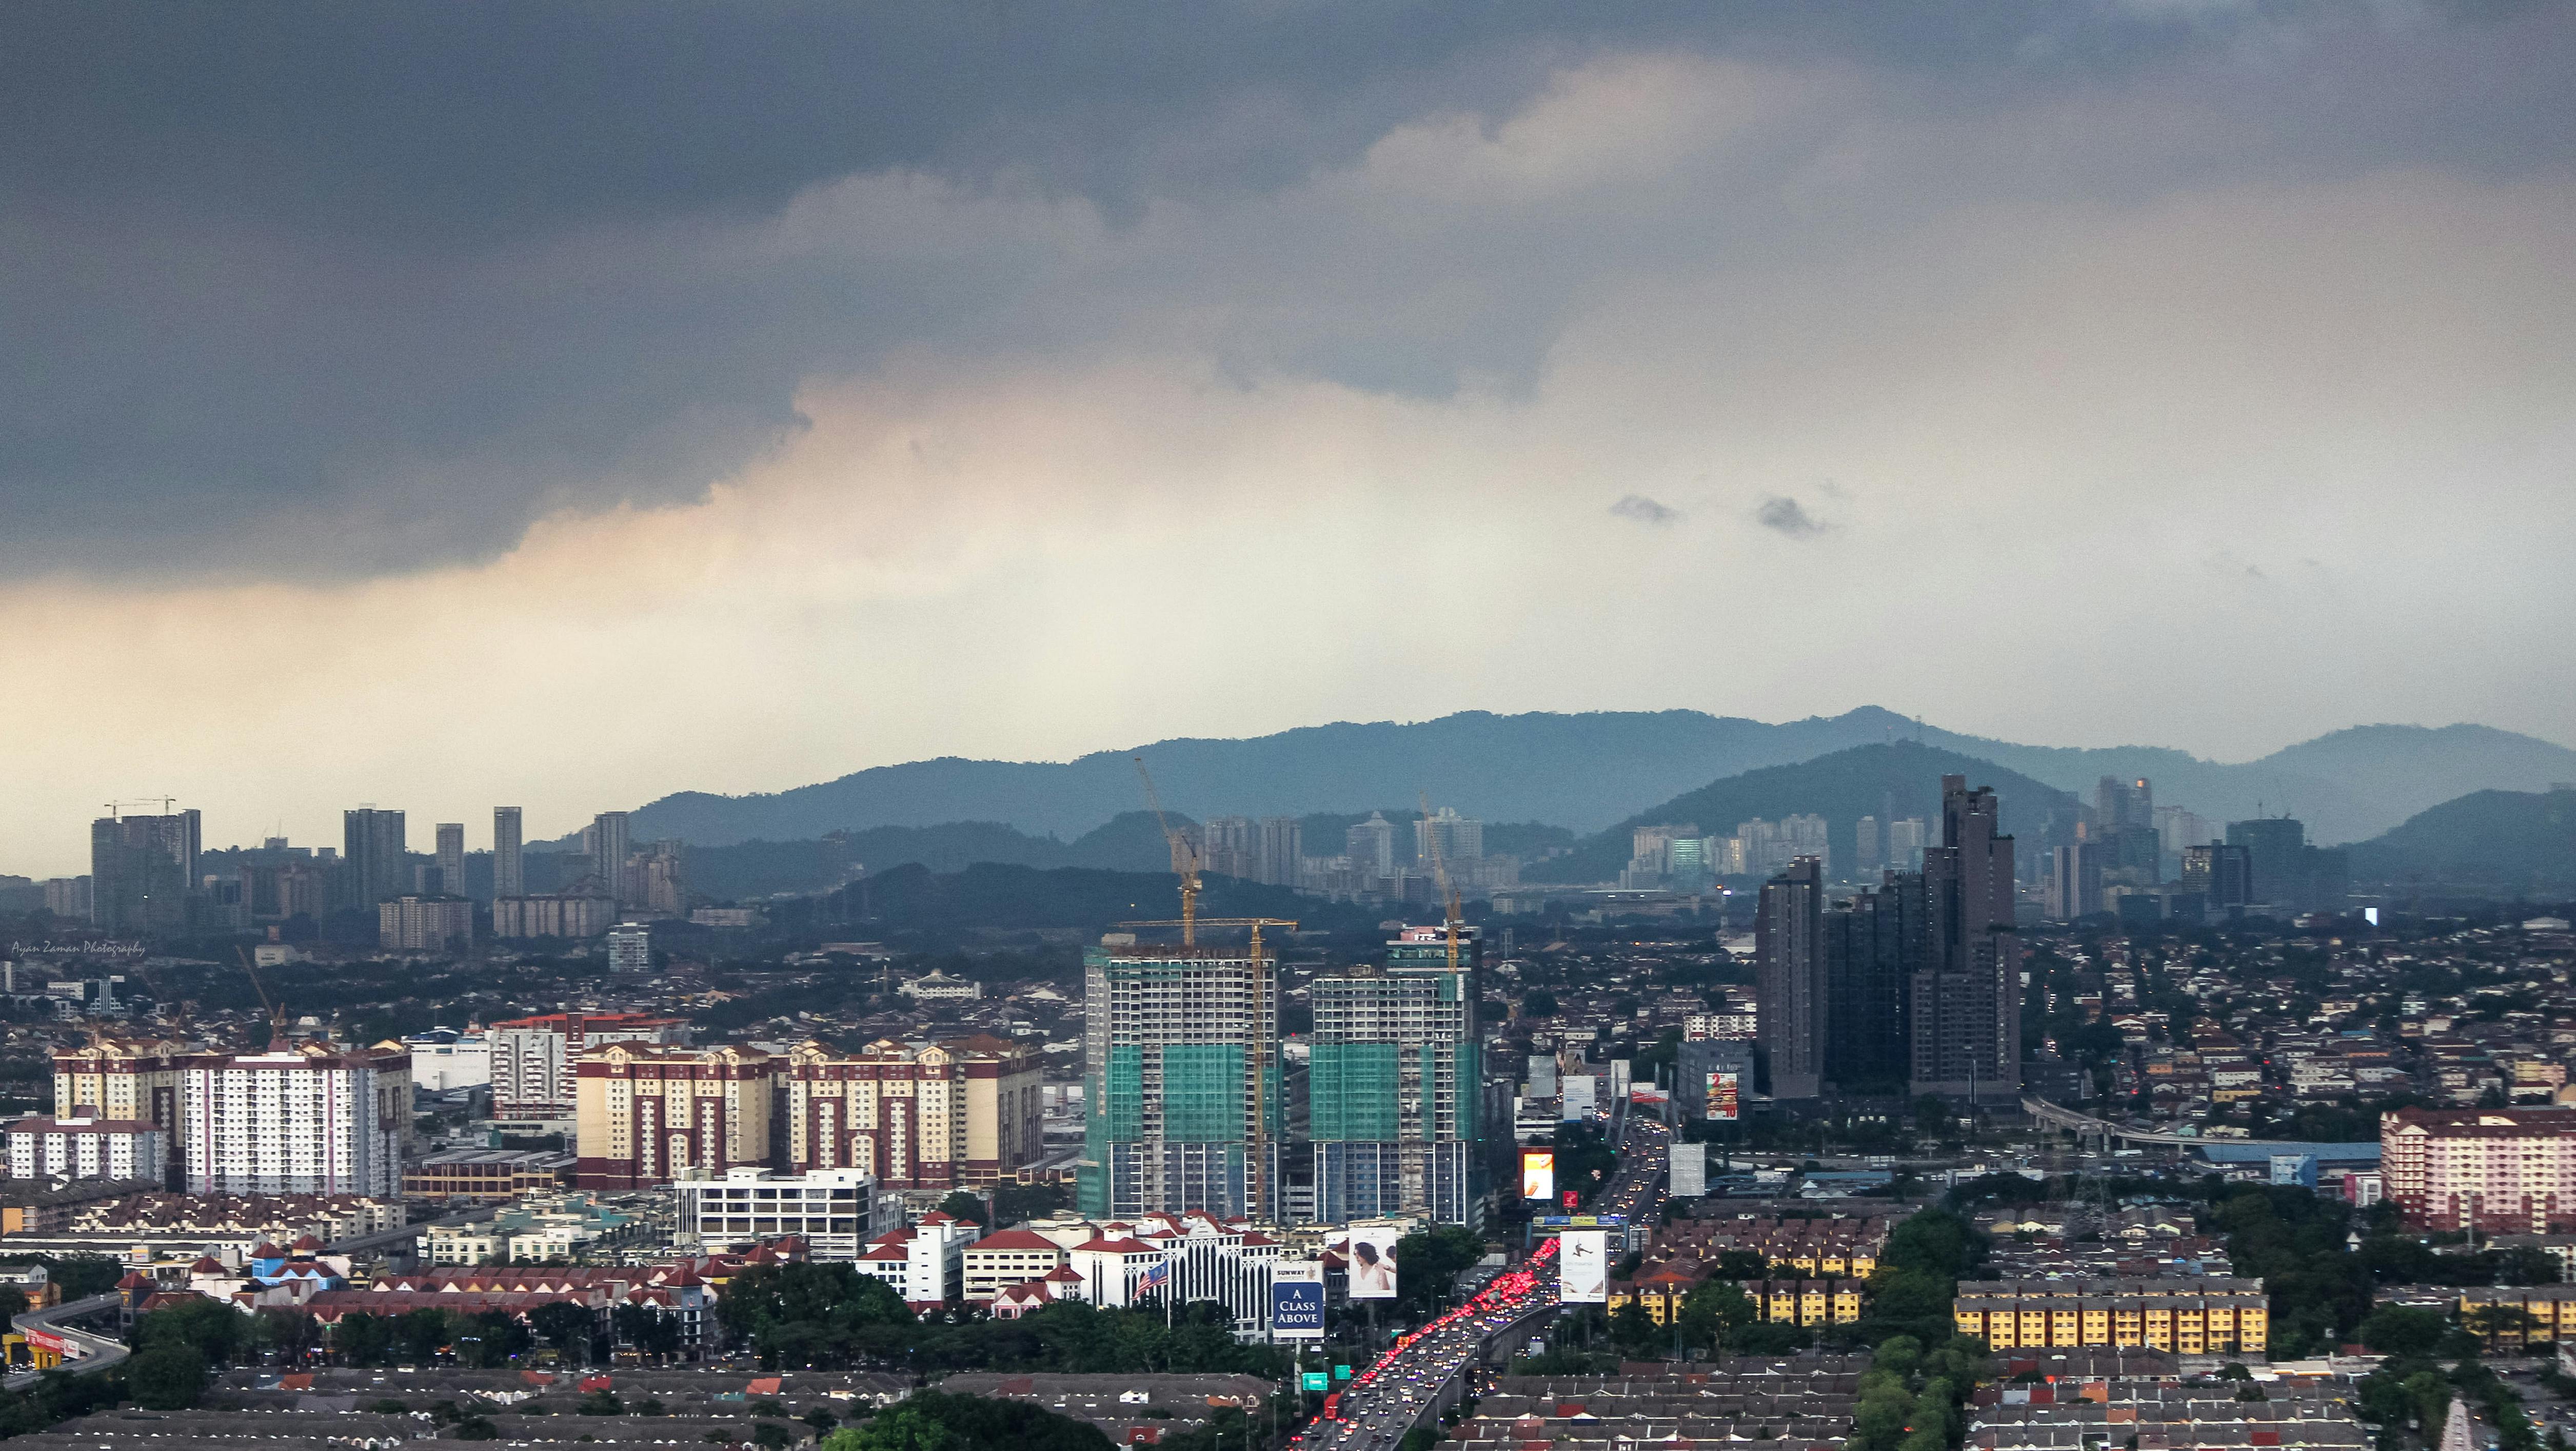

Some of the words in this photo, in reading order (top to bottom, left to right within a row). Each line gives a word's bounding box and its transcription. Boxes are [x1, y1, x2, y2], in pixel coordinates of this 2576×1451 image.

[1712, 1073, 1720, 1087] 2
[1293, 1289, 1302, 1299] A
[1279, 1301, 1316, 1311] CLASS
[1277, 1313, 1318, 1323] ABOVE
